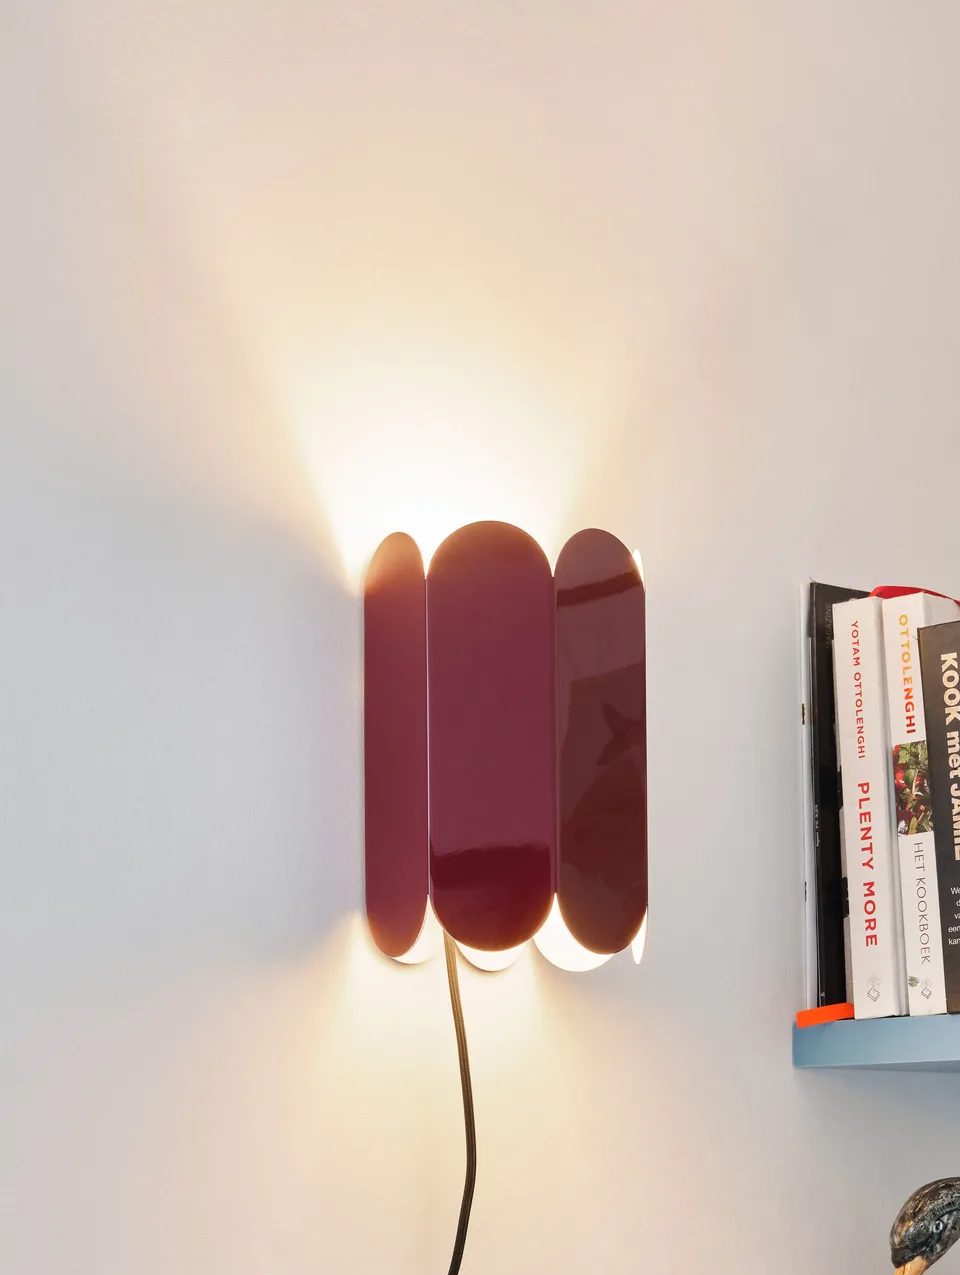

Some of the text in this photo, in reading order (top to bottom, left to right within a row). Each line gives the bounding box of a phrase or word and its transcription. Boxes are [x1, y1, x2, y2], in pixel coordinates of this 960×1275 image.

[850, 620, 866, 759] YOTAM OTTOLENGHI
[898, 614, 916, 734] OTTOLENGHI
[857, 781, 878, 947] PLENTY MORE
[913, 842, 931, 964] HET KOOKBOEK
